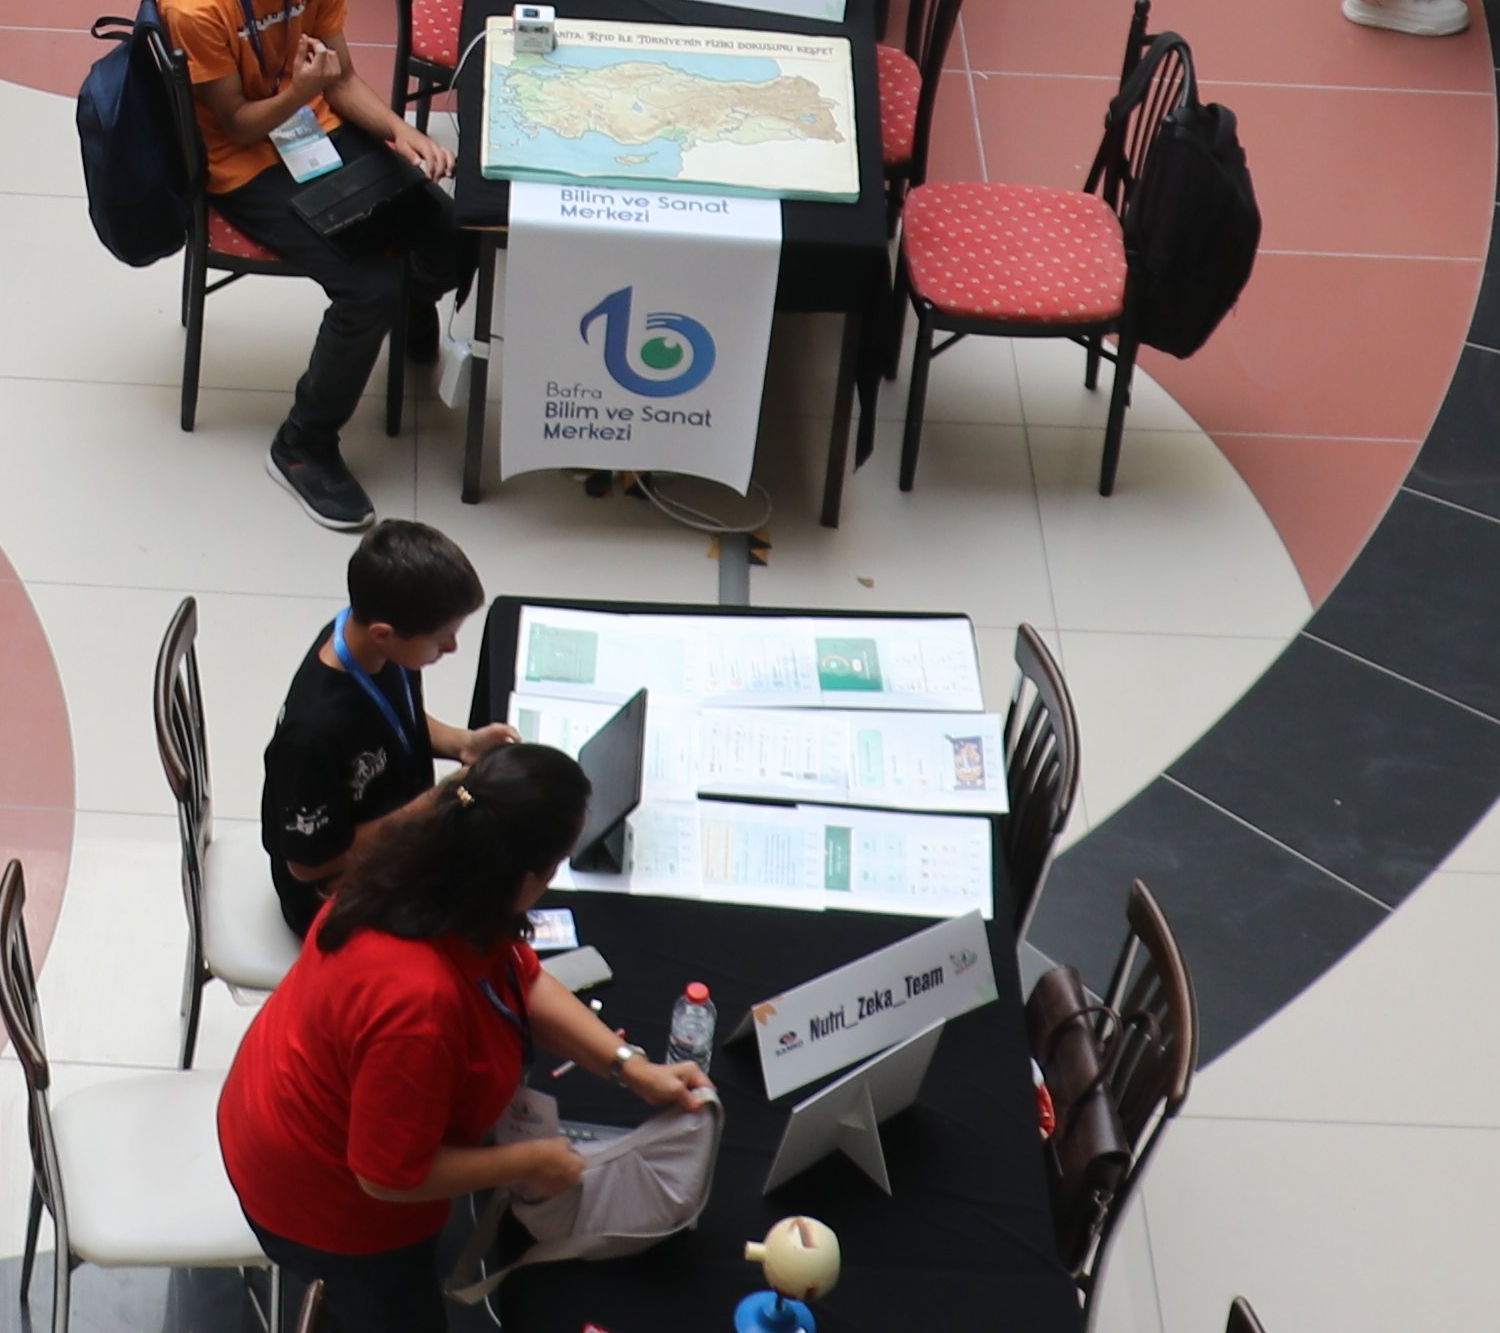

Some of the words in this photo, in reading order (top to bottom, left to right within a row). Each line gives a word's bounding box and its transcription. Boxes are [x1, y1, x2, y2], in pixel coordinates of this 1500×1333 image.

[560, 188, 616, 206] Bilim
[621, 195, 651, 209] ve
[658, 194, 729, 216] Sanat
[560, 205, 650, 224] Merkezi
[546, 382, 602, 399] Bafra
[544, 400, 599, 421] Bilim
[606, 406, 634, 422] ve
[640, 406, 712, 428] Sanat
[543, 422, 632, 442] Merkezi
[809, 965, 946, 1045] Nutri_Zeka_Team
